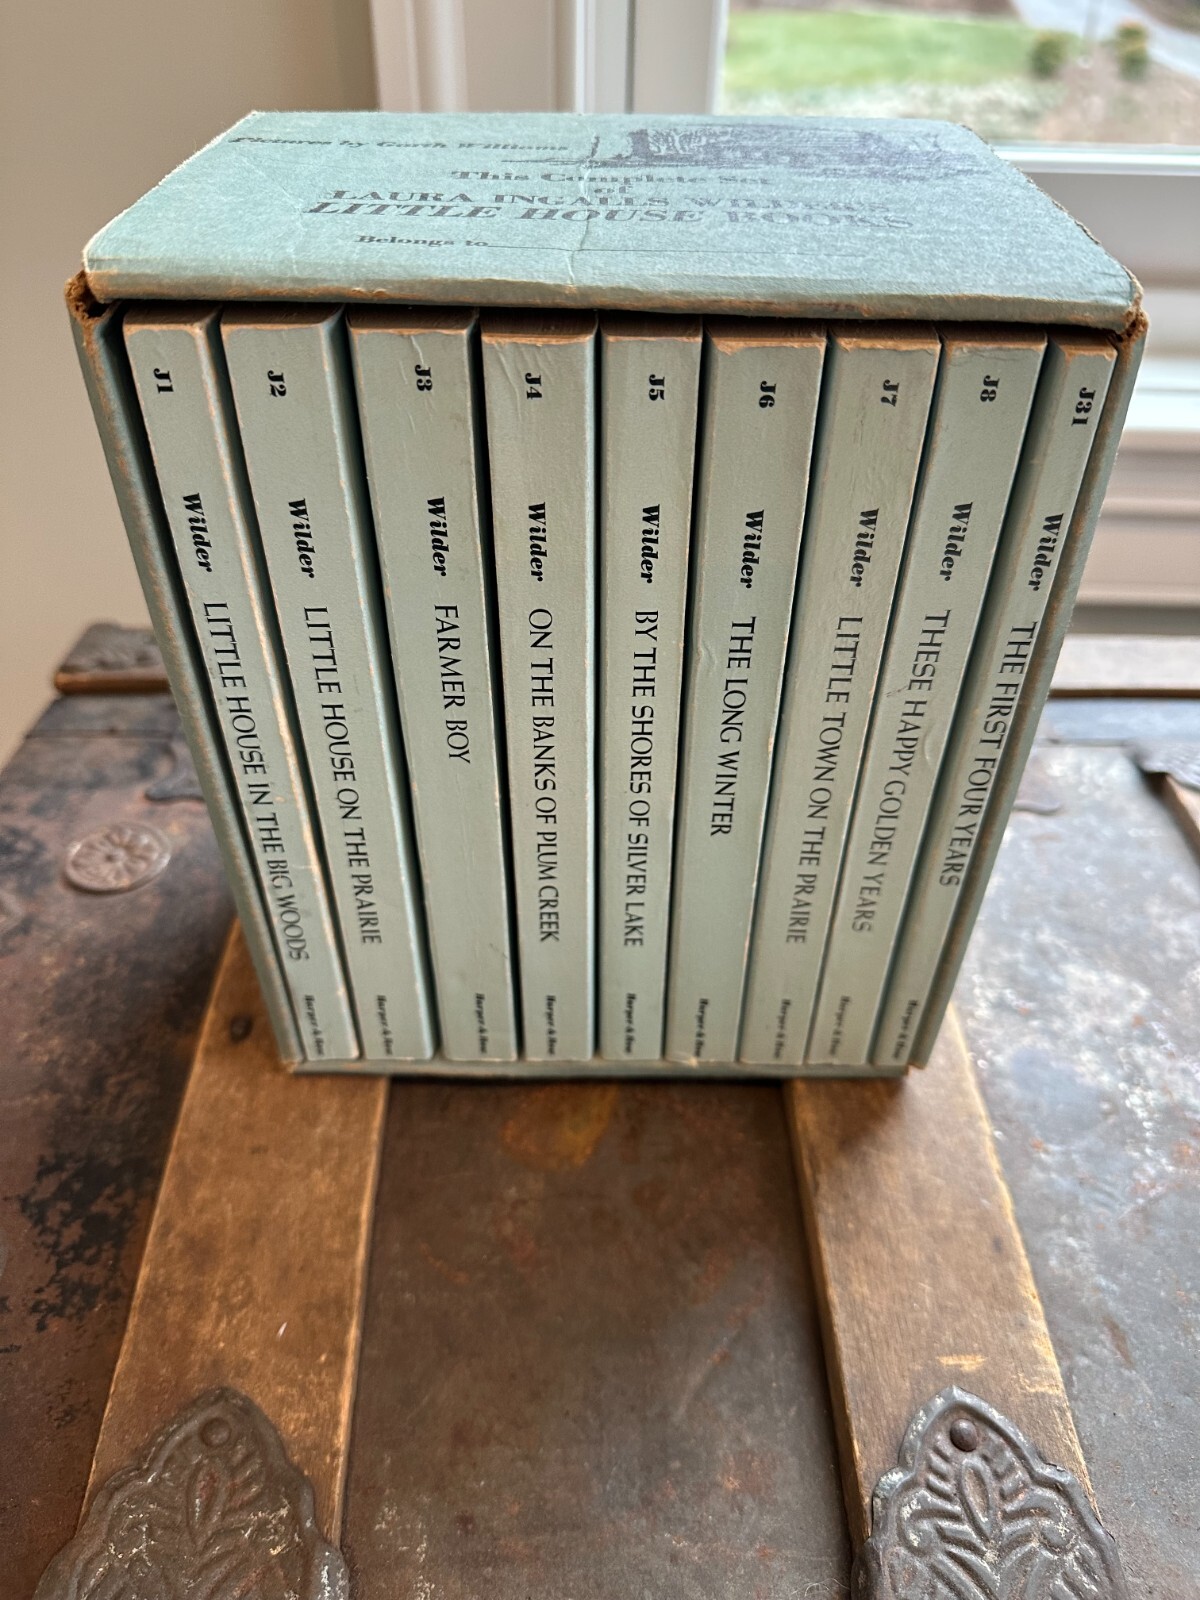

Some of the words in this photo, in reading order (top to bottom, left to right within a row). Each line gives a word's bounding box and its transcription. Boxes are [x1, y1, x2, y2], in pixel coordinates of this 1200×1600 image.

[229, 136, 333, 146] Pictures
[339, 139, 371, 148] by
[376, 140, 449, 149] Garth
[457, 142, 569, 152] Williams
[328, 189, 473, 204] LAURA
[493, 192, 669, 207] INGALLS
[451, 170, 530, 182] This
[540, 172, 708, 185] Complete
[593, 184, 634, 195] of
[301, 201, 502, 218] LITTLE
[514, 207, 707, 222] HOUSE
[722, 210, 915, 228] BOOKS
[353, 234, 456, 247] Belongs
[465, 239, 490, 247] to
[153, 367, 174, 394] J1
[267, 369, 287, 397] J2
[414, 363, 433, 392] J3
[525, 371, 543, 400] J4
[648, 373, 666, 401] J5
[758, 380, 776, 409] J6
[880, 379, 900, 407] J7
[979, 374, 1000, 403] J8
[183, 492, 213, 573] Wilder
[288, 497, 316, 579] Wilder
[427, 496, 450, 577] Wilder
[528, 501, 548, 582] Wilder
[640, 503, 661, 584] Wilder
[740, 508, 765, 589] Wilder
[850, 507, 879, 588] Wilder
[940, 501, 974, 582] Wilder
[1028, 512, 1065, 592] Wilder
[203, 602, 248, 688] LITTLE
[303, 605, 344, 694] LITTLE
[528, 607, 553, 650] ON
[634, 610, 659, 641] BY
[726, 616, 757, 669] THE
[908, 609, 952, 692] THESE
[997, 620, 1038, 675] THE
[434, 604, 466, 711] FARMER
[530, 658, 555, 707] THE
[632, 647, 657, 698] THE
[825, 615, 864, 704] LITTLE
[226, 695, 267, 775] HOUSE
[719, 678, 749, 744] LONG
[982, 681, 1020, 750] FIRST
[321, 703, 357, 782] HOUSE
[445, 718, 471, 765] BOY
[532, 715, 557, 791] BANKS
[630, 704, 655, 795] SHORES
[814, 711, 847, 782] TOWN
[888, 700, 928, 777] HAPPY
[247, 783, 275, 807] IN
[336, 787, 363, 820] ON
[534, 796, 557, 825] OF
[710, 750, 741, 837] WINTER
[807, 787, 833, 820] ON
[957, 757, 997, 817] FOUR
[256, 812, 285, 854] THE
[628, 800, 651, 828] OF
[866, 780, 906, 867] GOLDEN
[344, 827, 370, 868] THE
[536, 831, 559, 881] PLUM
[625, 832, 649, 896] SILVER
[799, 826, 825, 867] THE
[939, 821, 978, 888] YEARS
[267, 859, 293, 890] BIG
[277, 893, 310, 962] WOODS
[351, 873, 382, 945] PRAIRIE
[538, 884, 560, 943] CREEK
[623, 900, 646, 947] LAKE
[785, 873, 818, 945] PRAIRIE
[852, 871, 884, 934] YEARS
[304, 994, 320, 1026] Harper
[475, 992, 486, 1025] Harper
[545, 994, 556, 1027] Harper
[625, 992, 636, 1025] Harper
